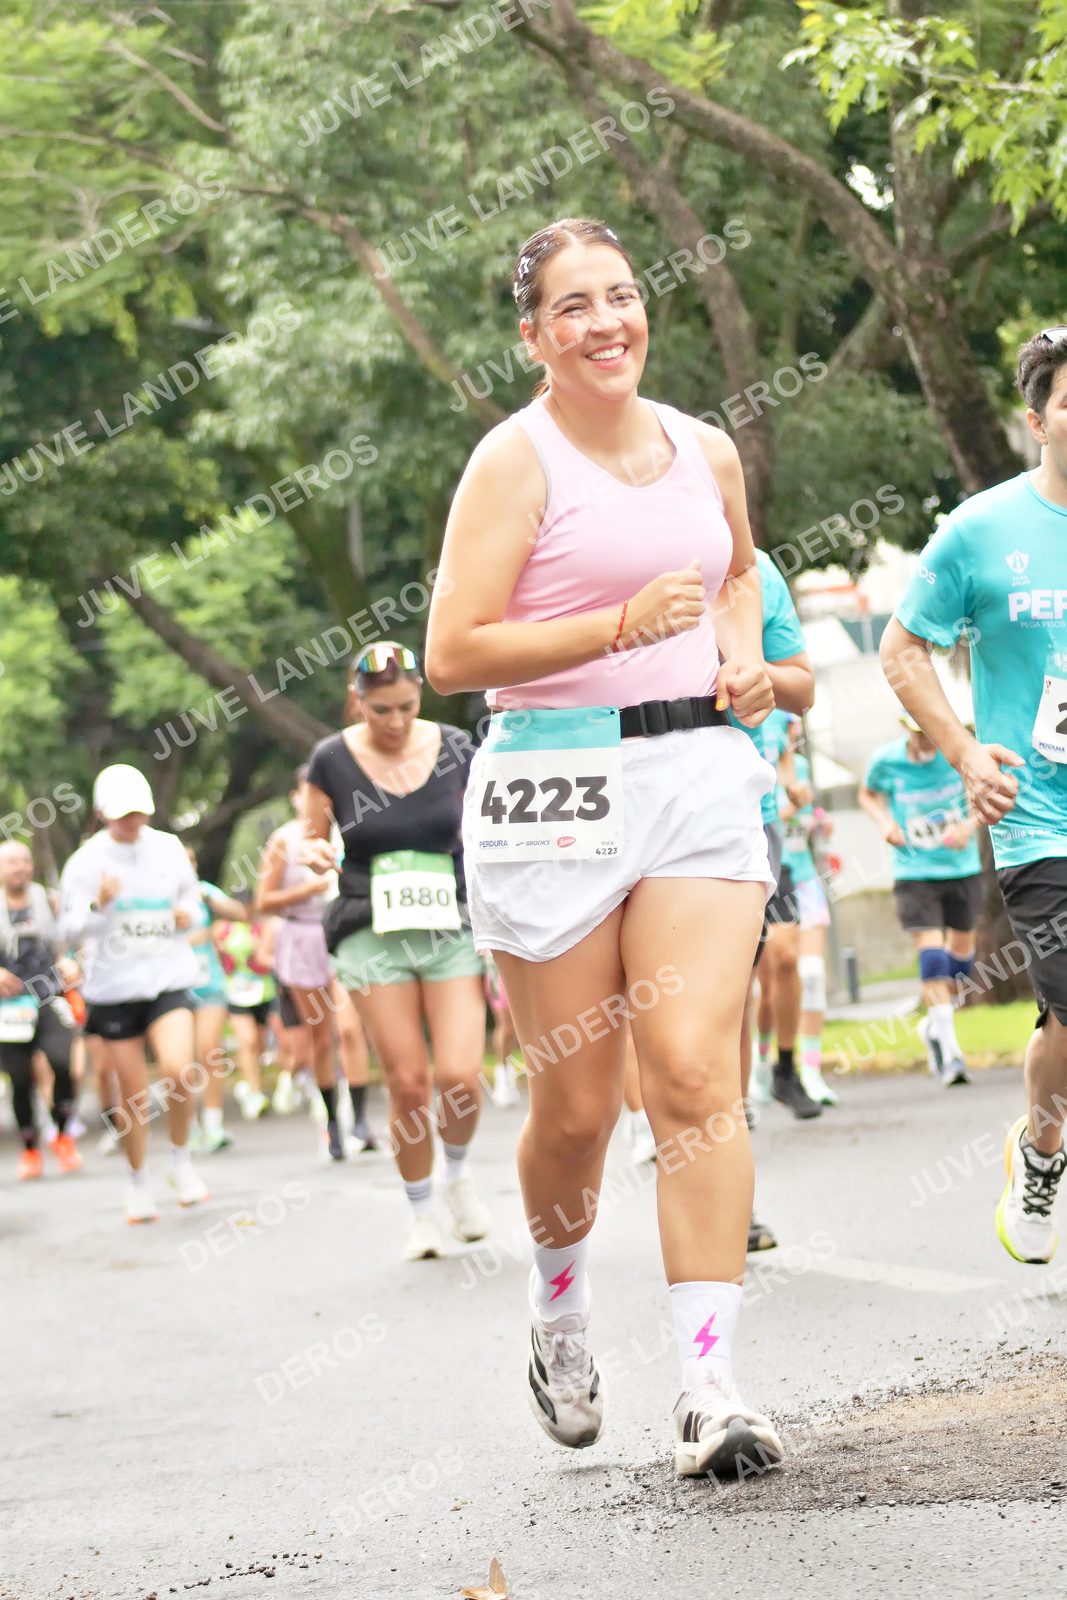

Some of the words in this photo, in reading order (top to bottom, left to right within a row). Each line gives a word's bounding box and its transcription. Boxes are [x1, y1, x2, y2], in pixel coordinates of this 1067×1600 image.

[481, 776, 610, 824] 4223
[595, 847, 618, 856] 4223
[383, 887, 449, 909] 1880
